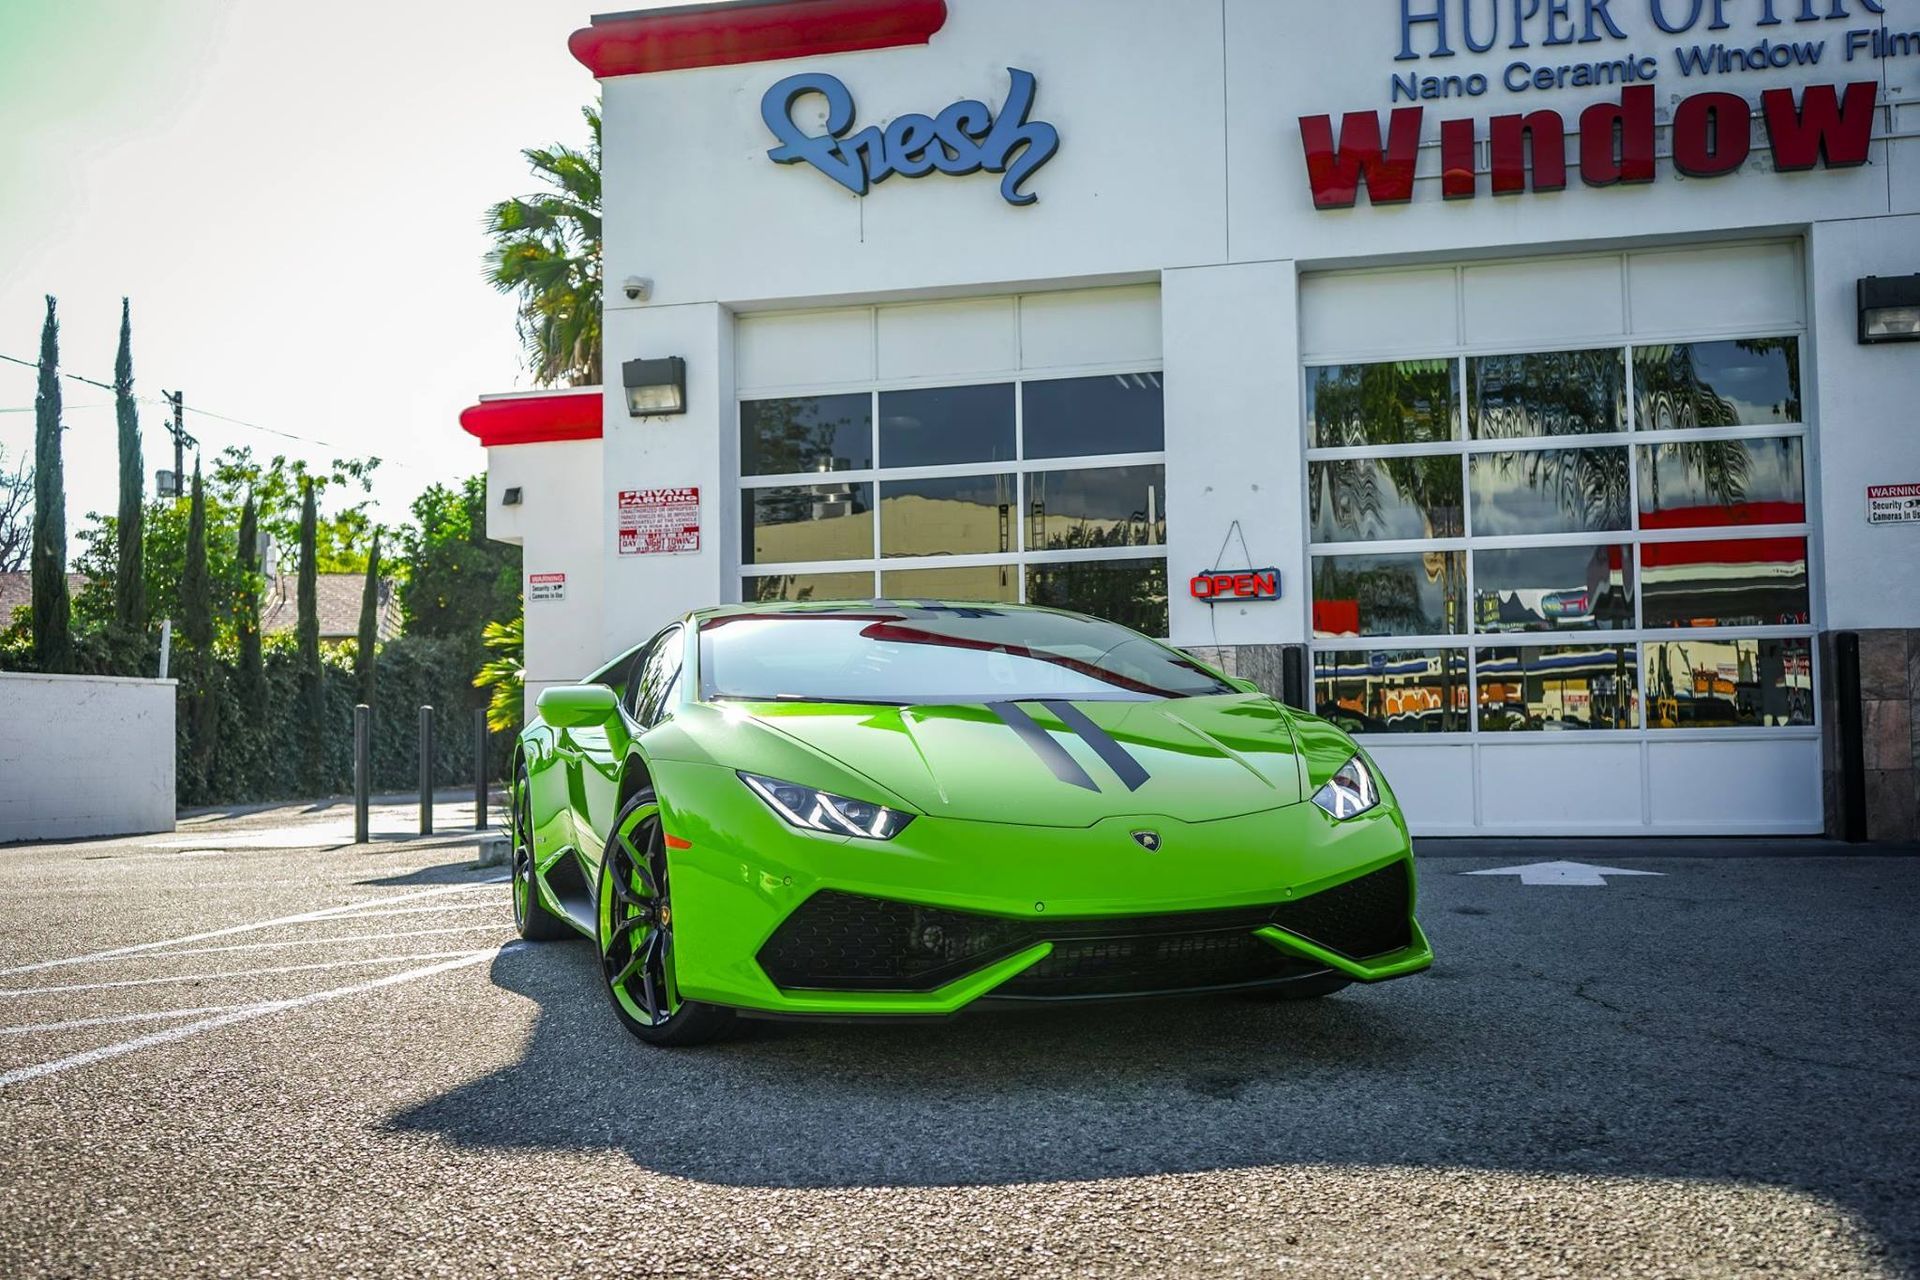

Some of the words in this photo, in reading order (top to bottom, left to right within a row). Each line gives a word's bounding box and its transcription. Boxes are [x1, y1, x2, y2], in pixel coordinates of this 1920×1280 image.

[1391, 71, 1488, 102] Nano
[1503, 53, 1657, 92] Ceramic
[1675, 39, 1825, 76] Window
[624, 489, 692, 498] PRIVATE
[620, 495, 697, 505] PARKING
[1872, 500, 1902, 511] Security
[1873, 512, 1902, 521] Cameras
[1904, 510, 1911, 519] In
[1912, 510, 1920, 519] Us
[645, 538, 665, 546] NIGHT
[667, 537, 695, 545] TOWING
[1190, 573, 1275, 597] OPEN
